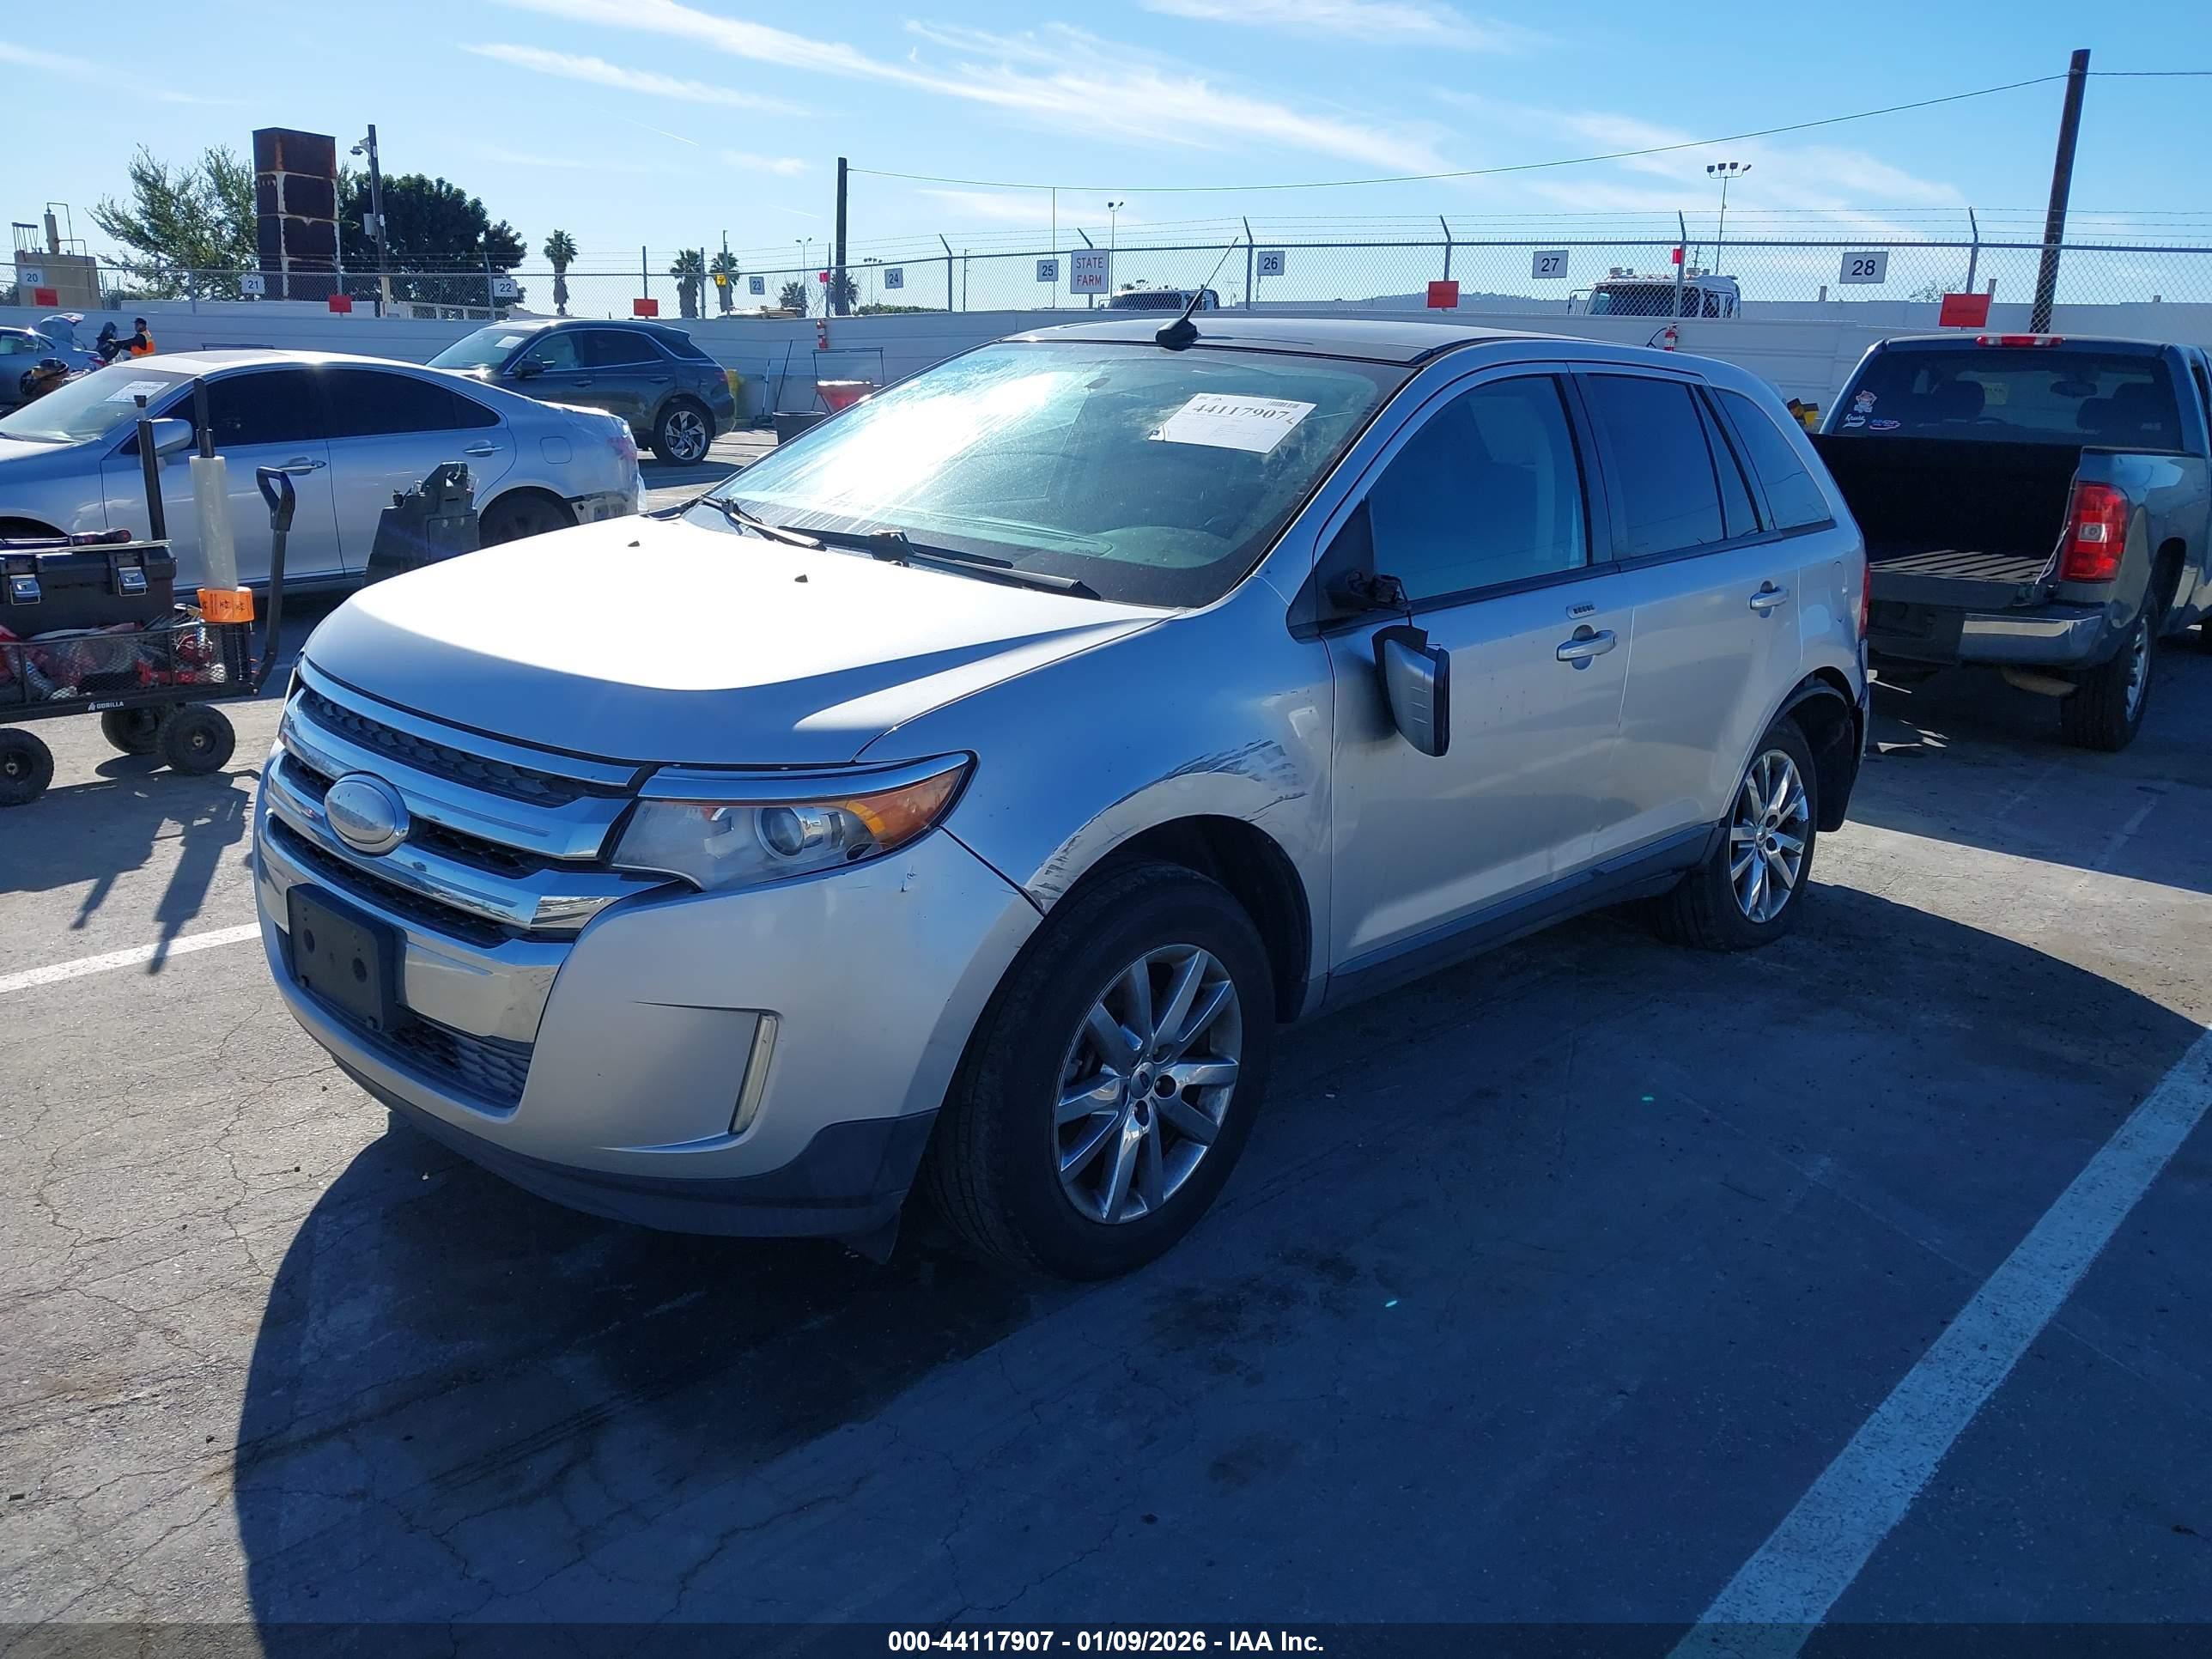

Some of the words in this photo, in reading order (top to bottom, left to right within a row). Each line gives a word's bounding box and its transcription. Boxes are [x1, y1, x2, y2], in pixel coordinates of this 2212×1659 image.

[1076, 257, 1103, 269] STATE
[1263, 257, 1278, 270] 26
[1540, 258, 1560, 272] 27
[1851, 259, 1876, 276] 28
[1042, 264, 1054, 276] 25
[27, 273, 39, 283] 20
[889, 273, 899, 284] 24
[1077, 274, 1102, 287] FARM
[247, 280, 258, 289] 21
[500, 283, 512, 293] 22
[752, 281, 762, 290] 23
[1192, 404, 1291, 421] 44117907
[96, 701, 125, 709] GORILLA
